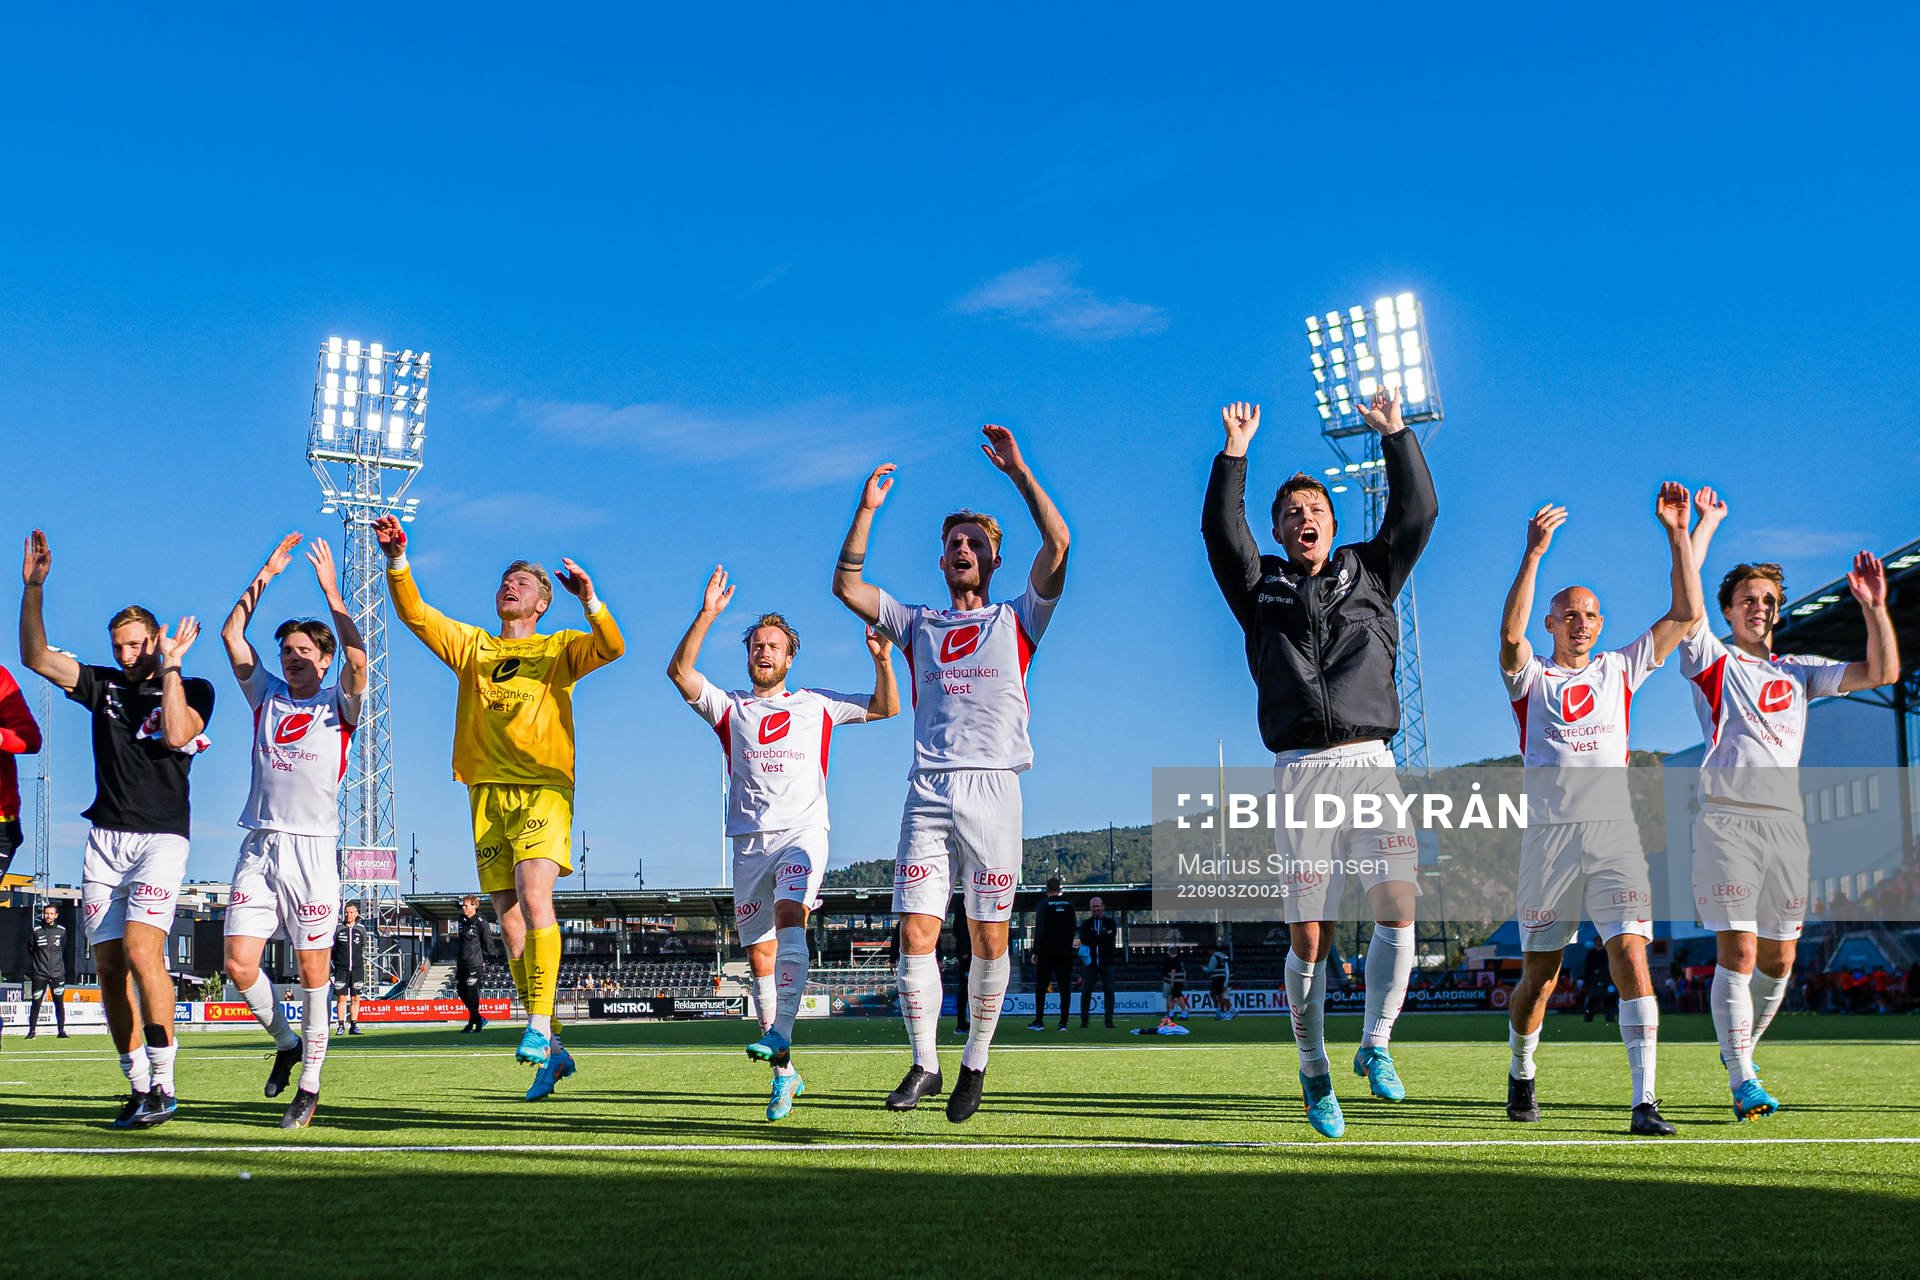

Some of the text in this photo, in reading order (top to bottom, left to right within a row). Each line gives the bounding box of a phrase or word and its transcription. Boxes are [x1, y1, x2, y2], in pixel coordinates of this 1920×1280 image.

[923, 665, 999, 684] Sparebanken
[943, 683, 972, 695] Vest
[486, 699, 510, 712] Vest
[1570, 740, 1600, 752] Vest
[742, 747, 805, 761] Sparebanken
[271, 758, 293, 772] Vest
[760, 761, 784, 773] Vest
[1378, 834, 1417, 850] LERØ
[476, 843, 501, 860] RØY
[354, 859, 390, 869] HORISONT
[895, 863, 932, 880] ERØY
[972, 872, 1016, 888] LERØY
[1407, 989, 1486, 1001] POLARDRIKK
[377, 1004, 391, 1012] salt
[416, 1004, 430, 1012] salt
[494, 1003, 508, 1011] salt
[603, 1002, 654, 1013] MISTROL
[674, 1000, 726, 1010] Reklamehuset
[225, 1007, 253, 1016] EXTRA
